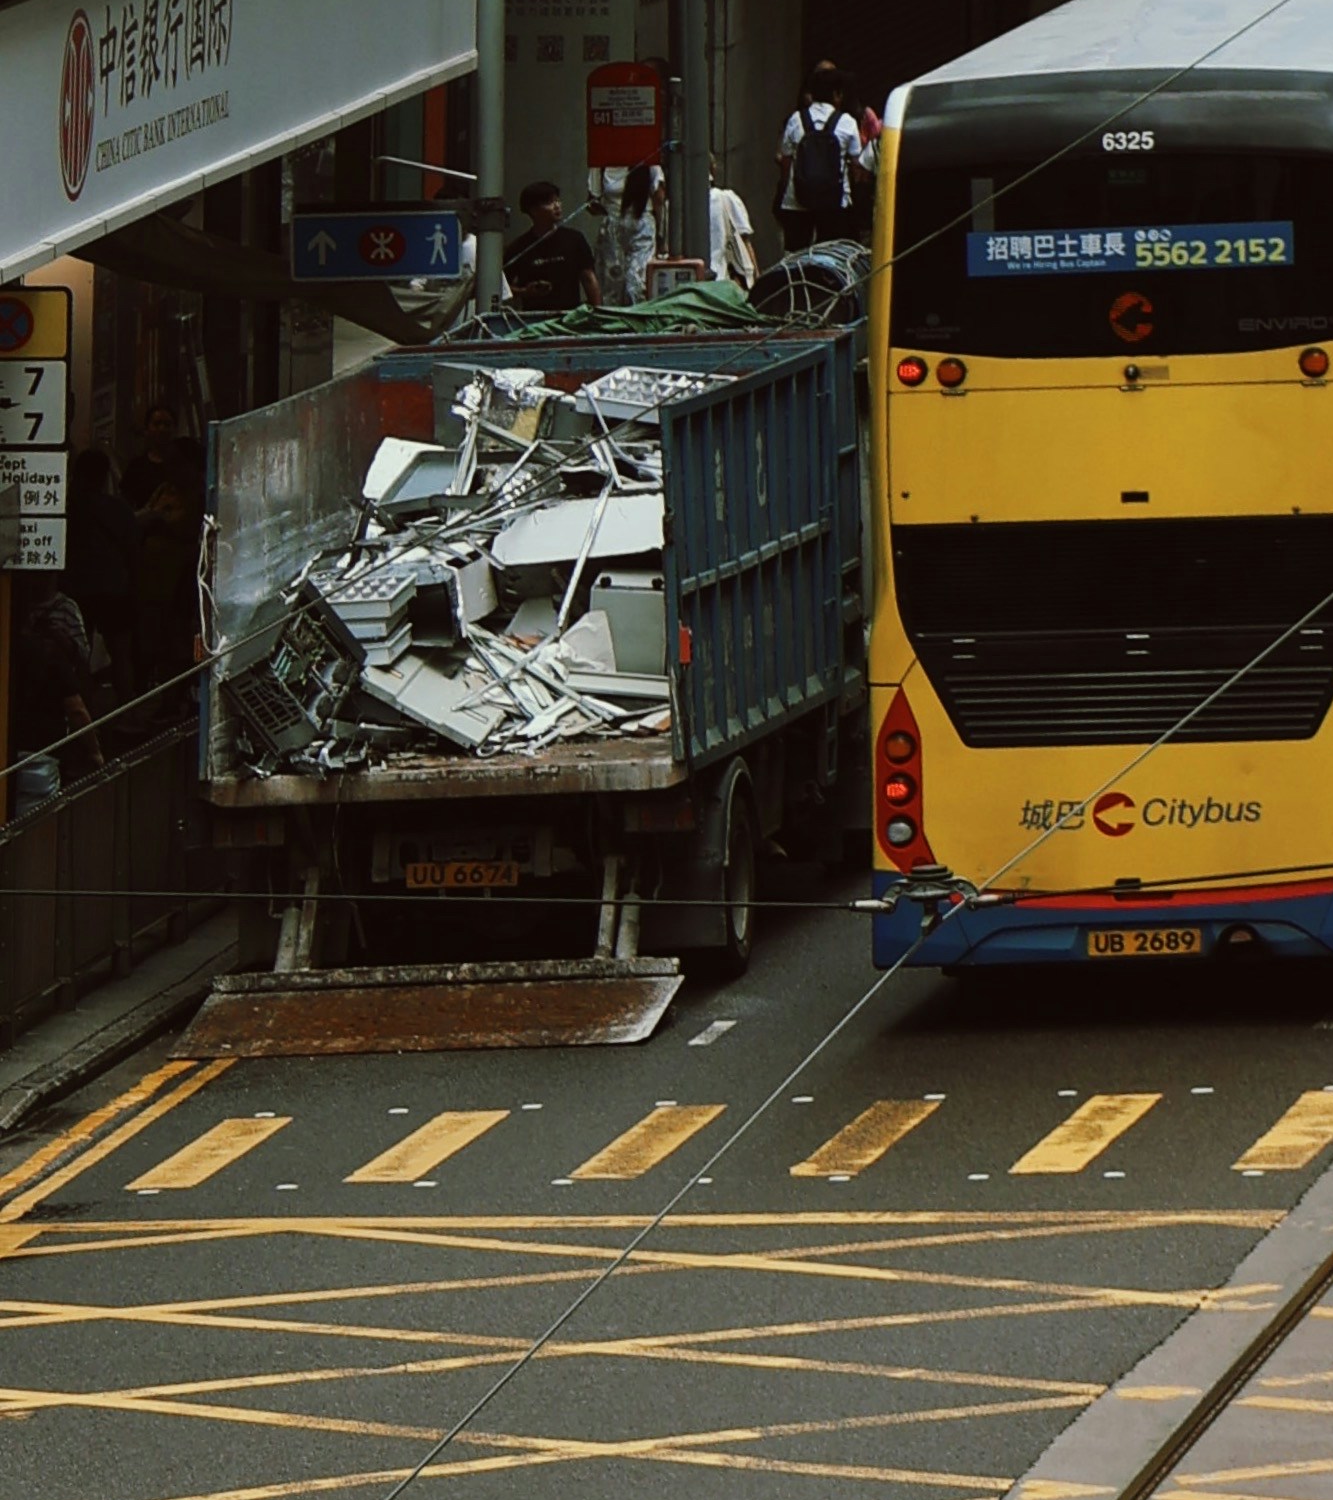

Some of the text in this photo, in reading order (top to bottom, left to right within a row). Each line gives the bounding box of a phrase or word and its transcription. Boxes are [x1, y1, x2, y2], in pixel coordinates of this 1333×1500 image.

[122, 126, 142, 162] CITIC
[143, 115, 166, 152] BANK
[167, 90, 230, 143] INTERNATIONAL
[1102, 131, 1155, 152] 6325
[986, 231, 1126, 262] 招聘巴士車長
[1135, 237, 1286, 268] 5562 2152
[24, 367, 44, 396] 7
[23, 412, 44, 441] 7
[2, 471, 61, 486] Holidays
[1019, 795, 1262, 833] 城巴 Citybus
[1094, 930, 1196, 953] UB 2689
